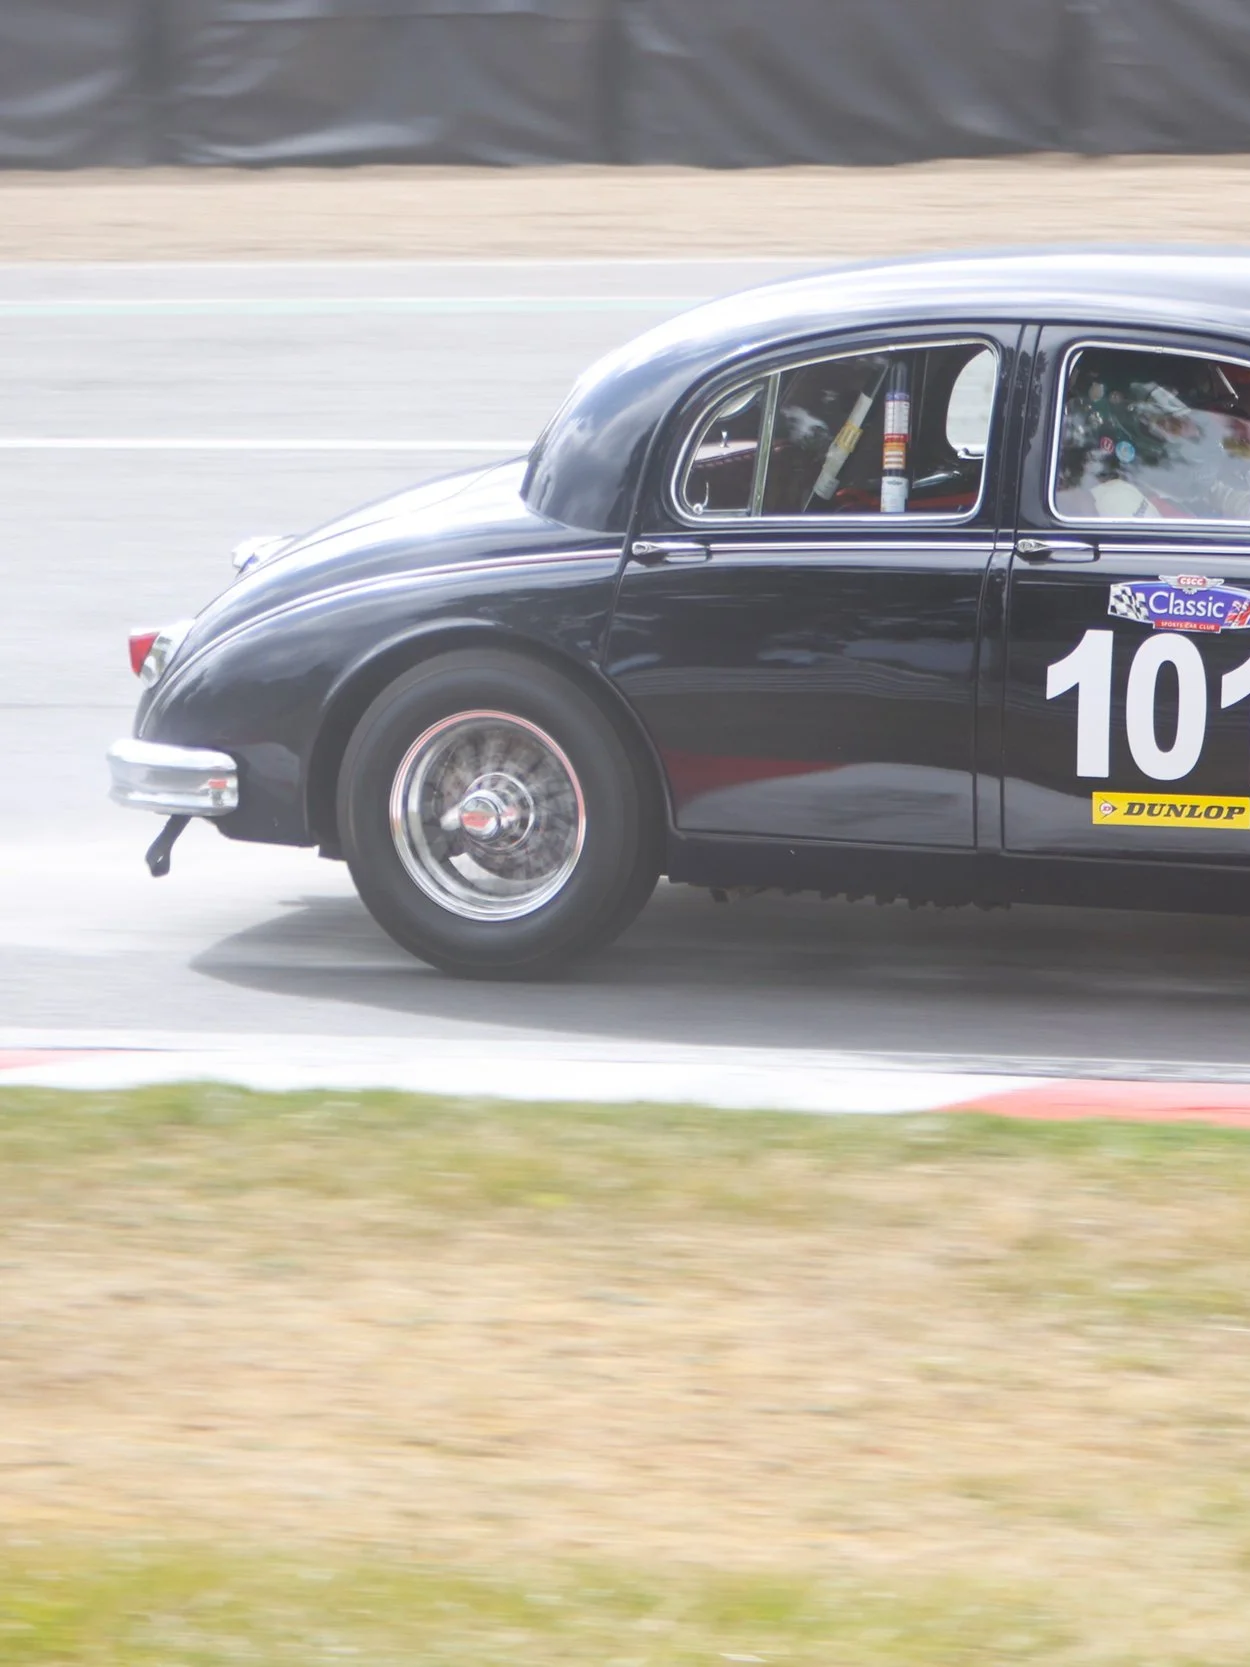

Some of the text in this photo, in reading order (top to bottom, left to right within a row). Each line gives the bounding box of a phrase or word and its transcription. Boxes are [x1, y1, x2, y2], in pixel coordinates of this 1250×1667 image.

[1179, 577, 1206, 586] CSCC
[1149, 591, 1224, 618] Classic
[1160, 620, 1183, 629] SPORTS
[1123, 802, 1245, 820] DUNLOP
